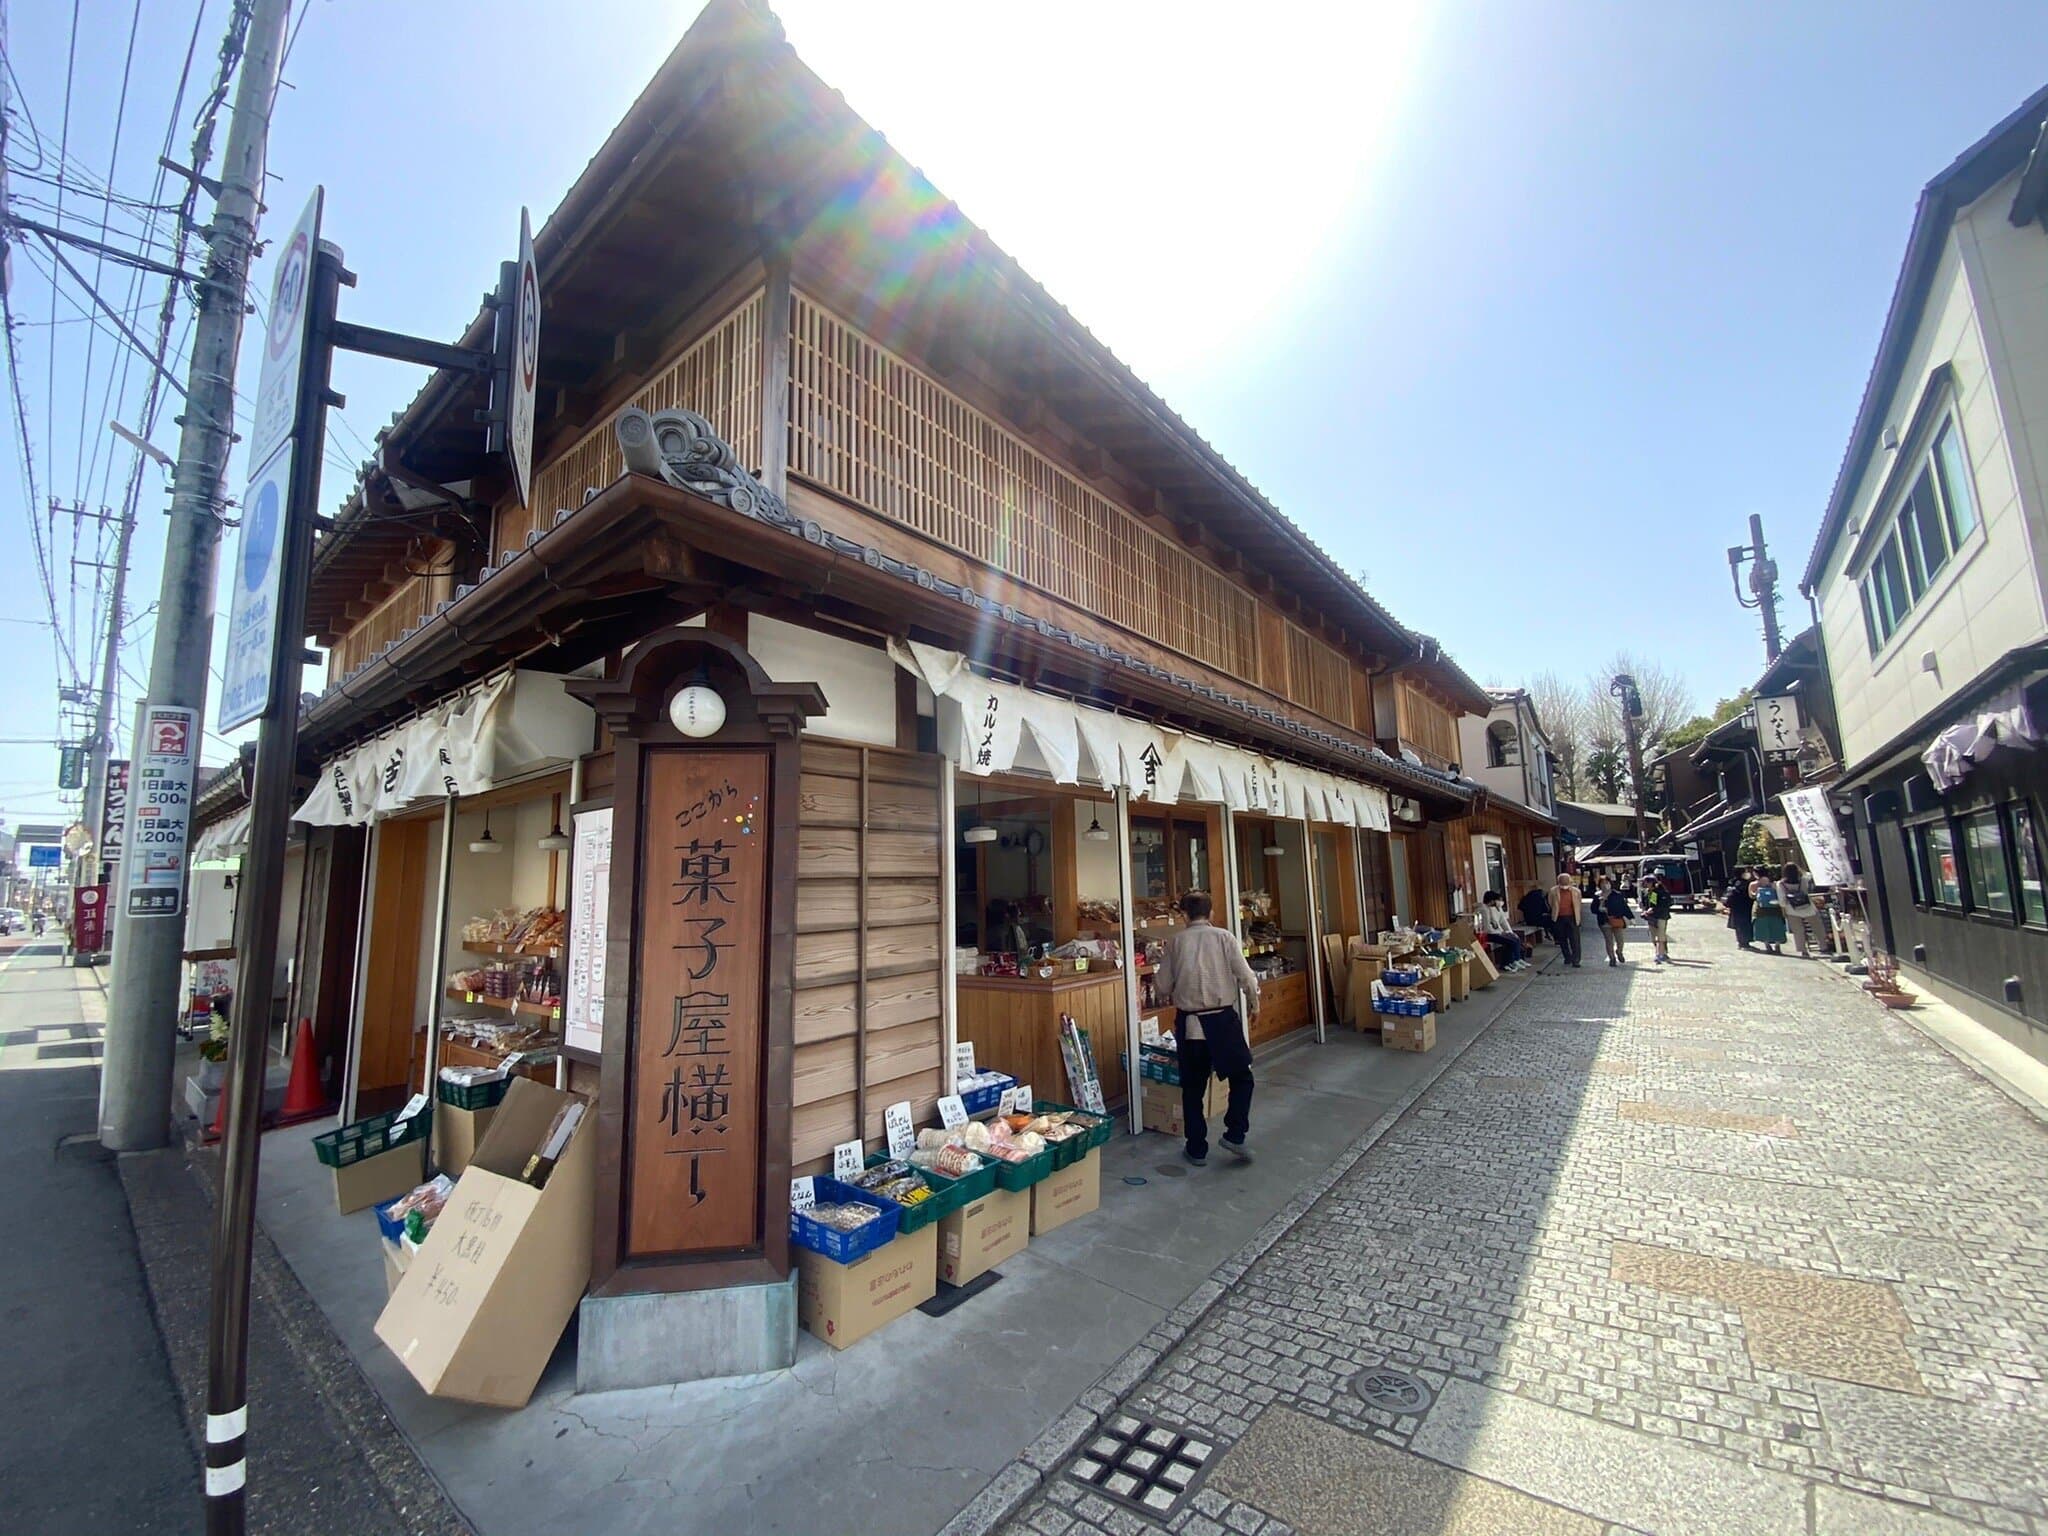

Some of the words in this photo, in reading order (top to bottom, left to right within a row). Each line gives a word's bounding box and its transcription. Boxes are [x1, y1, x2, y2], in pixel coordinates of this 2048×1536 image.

[976, 694, 998, 766] カルメ焼
[1768, 700, 1790, 748] うなぎ
[144, 756, 189, 766] パーキング
[141, 780, 188, 792] 1日最大
[148, 793, 187, 804] 500円
[676, 779, 738, 827] ここから
[138, 819, 184, 829] 1日最大
[137, 832, 183, 843] 1,200円
[658, 839, 738, 1207] 菓子屋横丁
